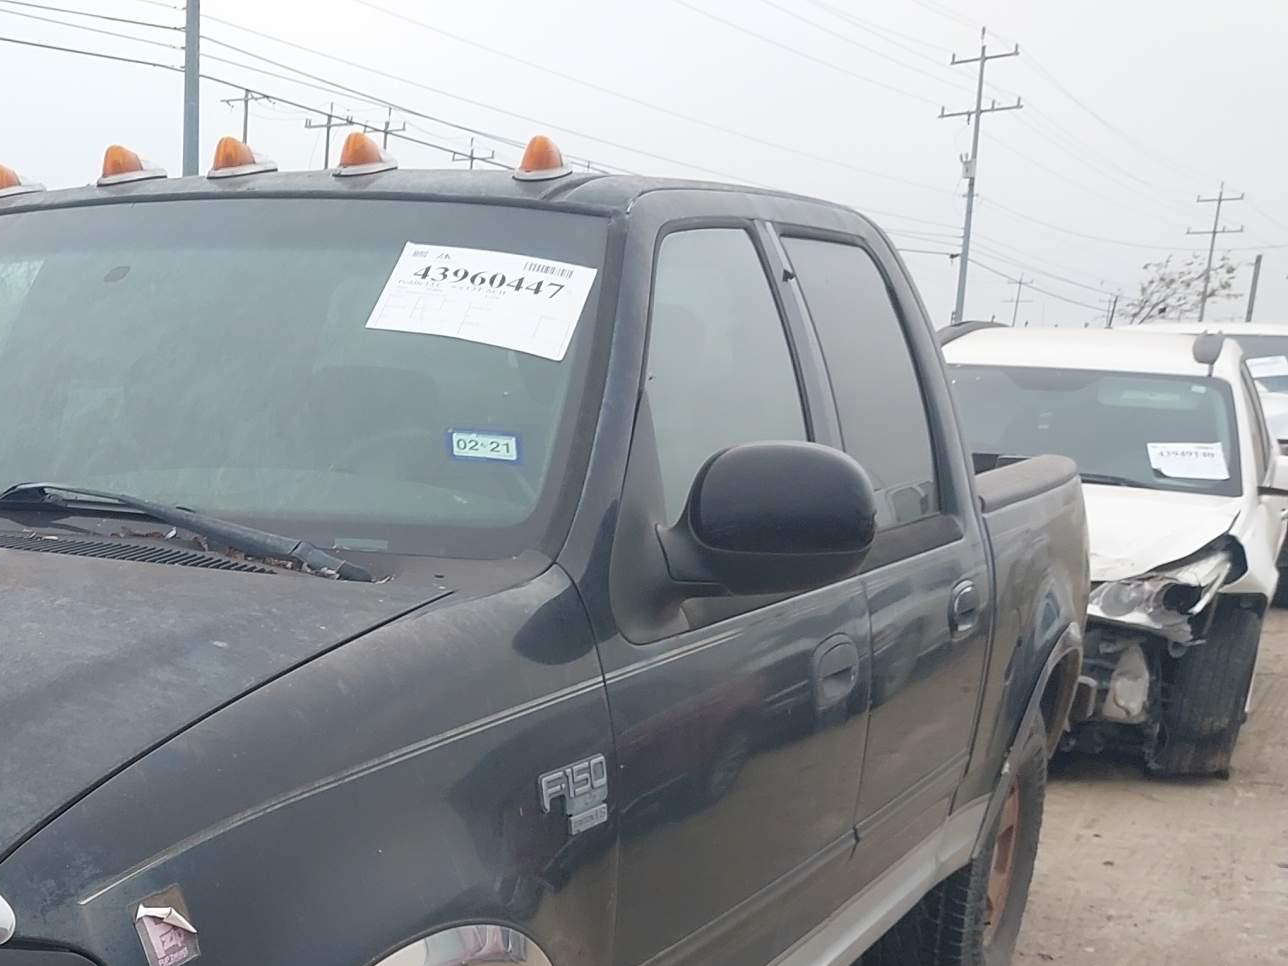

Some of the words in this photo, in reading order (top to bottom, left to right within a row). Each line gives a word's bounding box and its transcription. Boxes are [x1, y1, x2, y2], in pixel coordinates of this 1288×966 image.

[413, 265, 565, 299] 43960447
[456, 438, 479, 451] 02
[489, 440, 510, 454] 21
